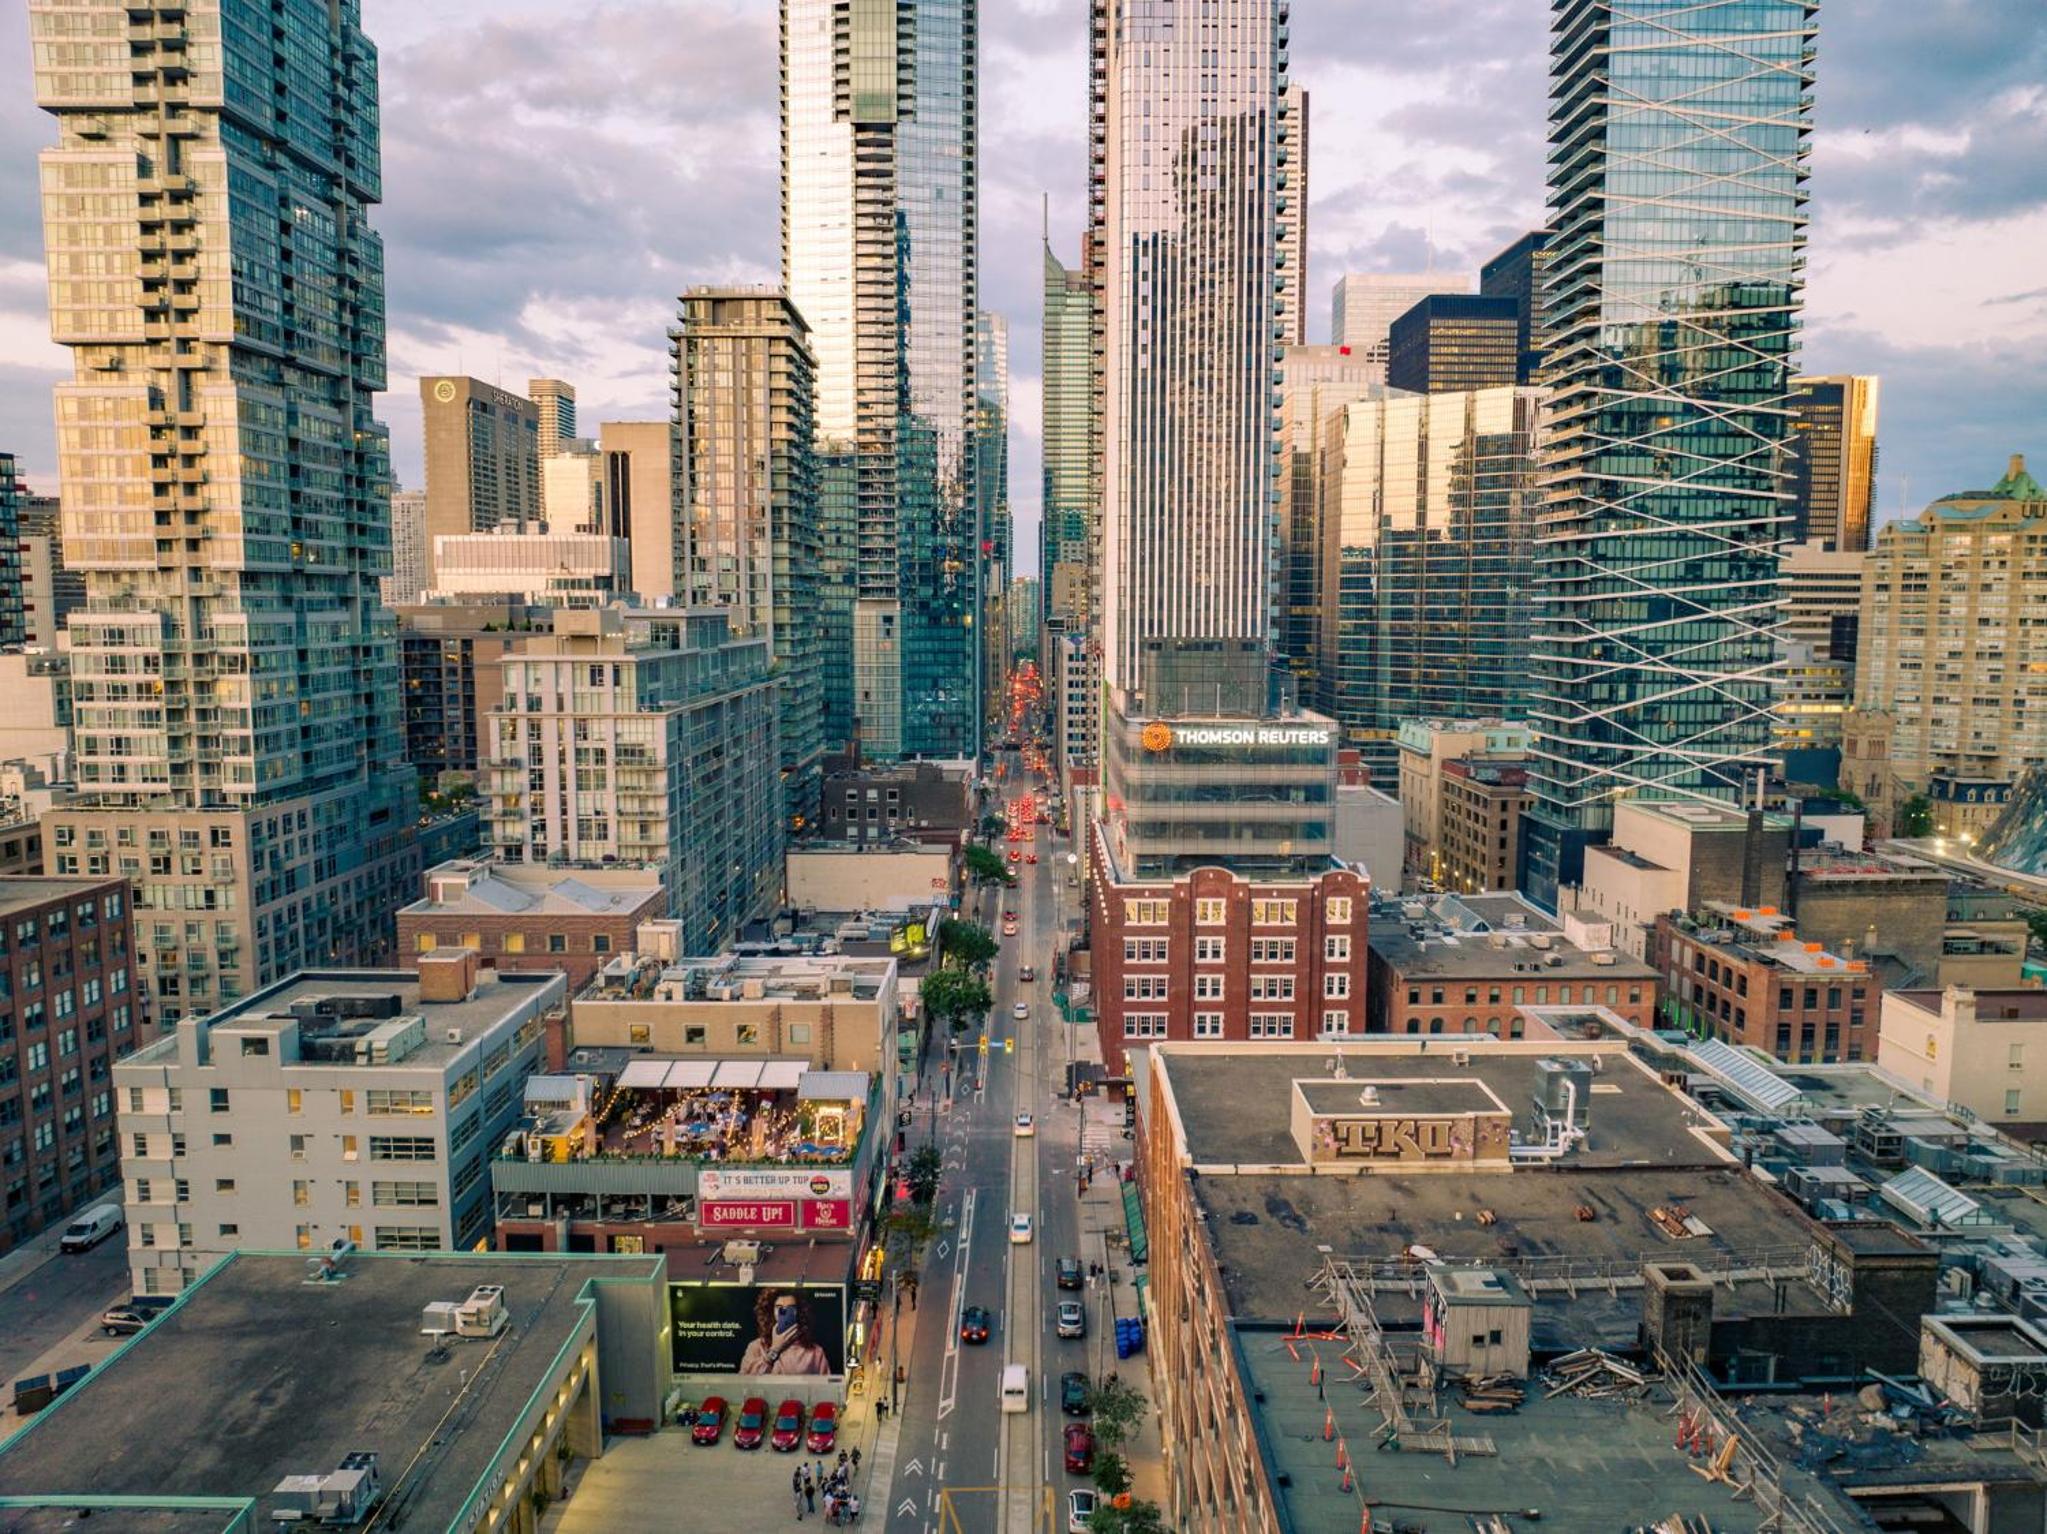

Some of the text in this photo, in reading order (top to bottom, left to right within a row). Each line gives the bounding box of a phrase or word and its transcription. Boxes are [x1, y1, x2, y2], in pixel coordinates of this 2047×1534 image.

[1177, 730, 1329, 744] THOMSON REUTERS
[743, 1175, 776, 1185] BETTER
[778, 1175, 790, 1185] UP
[792, 1175, 809, 1185] TOP
[713, 1206, 783, 1222] SADDLE UP!
[678, 1321, 742, 1329] Your health data.
